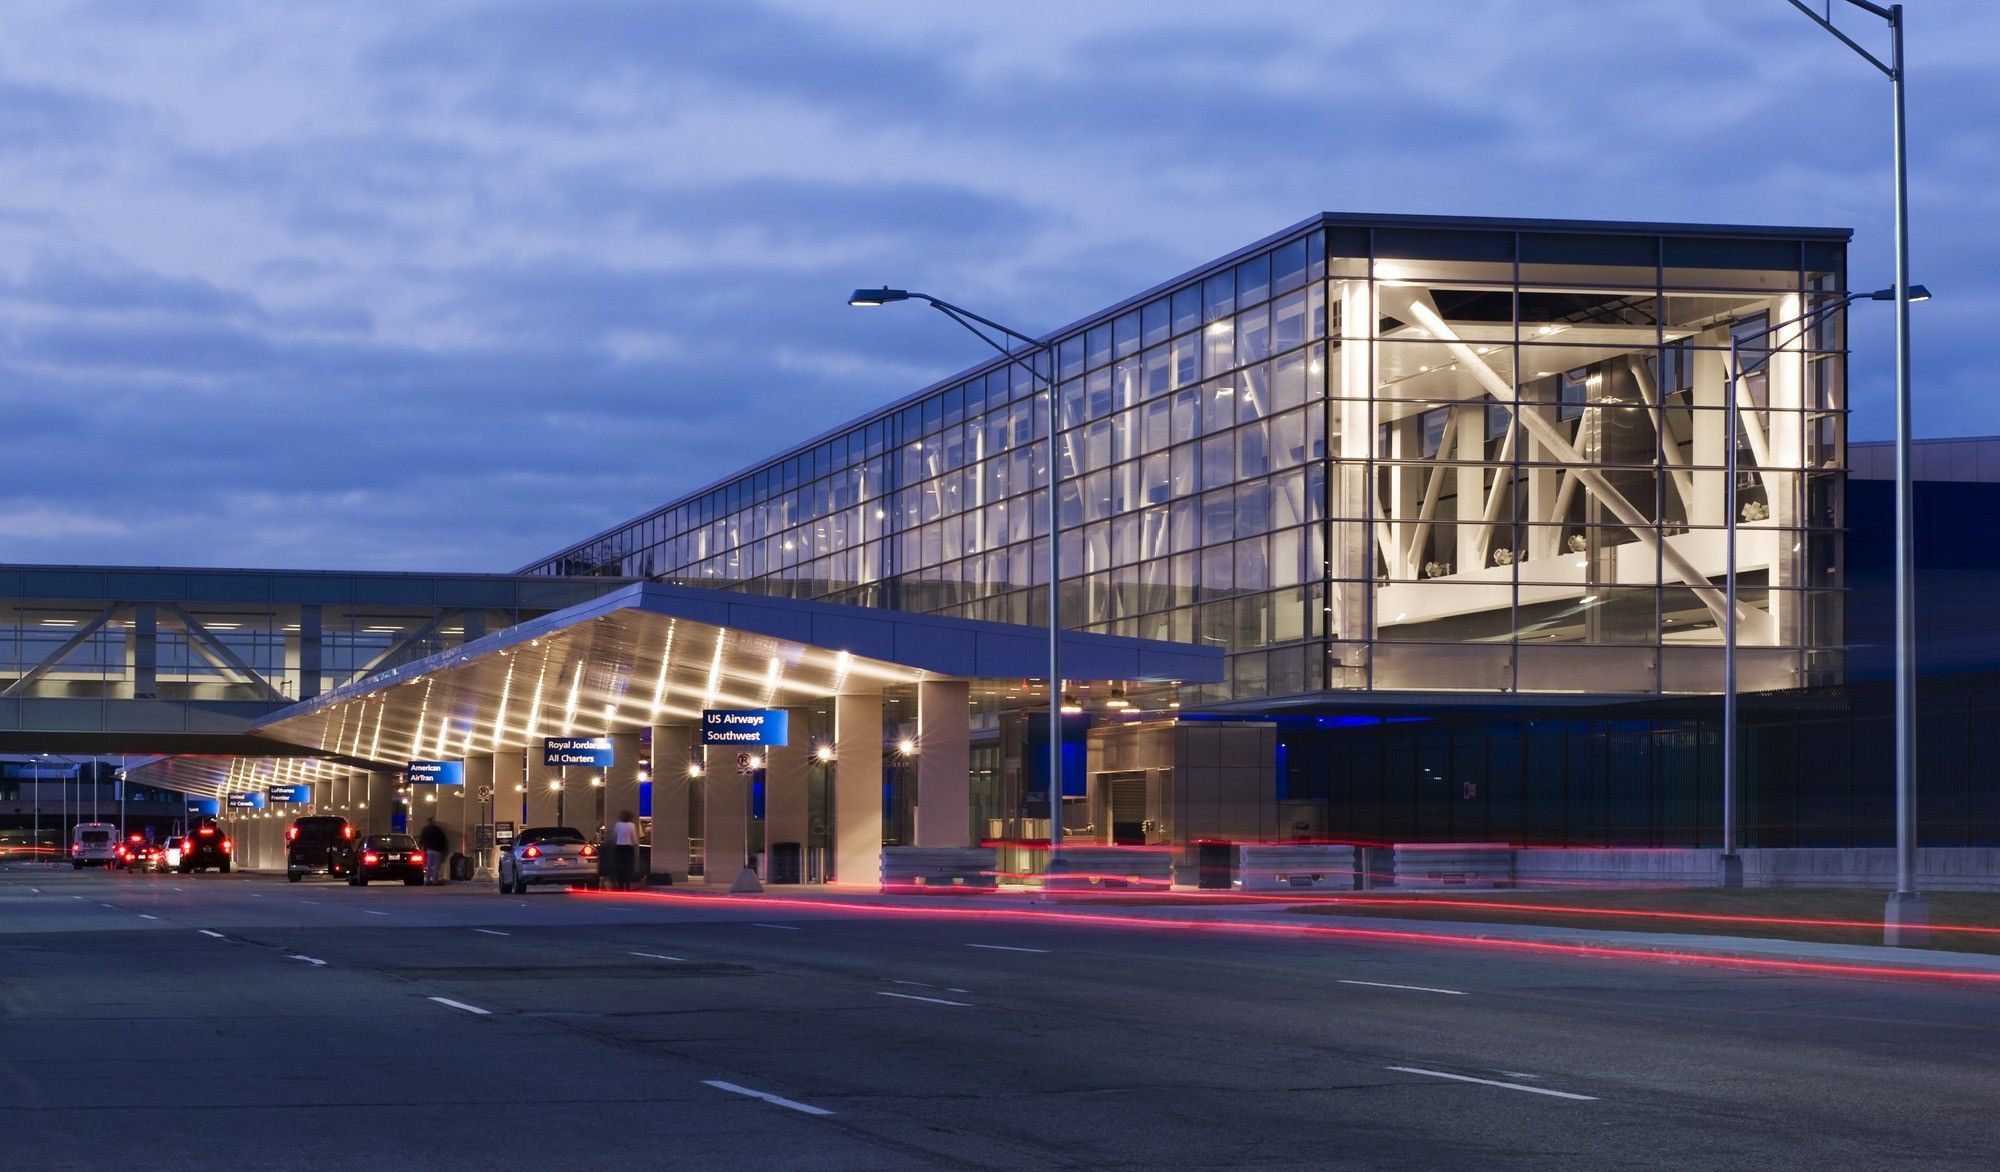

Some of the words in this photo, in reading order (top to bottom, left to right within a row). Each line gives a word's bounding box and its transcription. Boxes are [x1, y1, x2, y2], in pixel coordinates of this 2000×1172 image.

[707, 714, 722, 724] US
[724, 714, 764, 726] Airways
[707, 730, 761, 741] Southwest
[548, 741, 571, 750] Royal
[572, 741, 611, 749] Jordan
[548, 754, 559, 762] All
[561, 754, 595, 763] Charters
